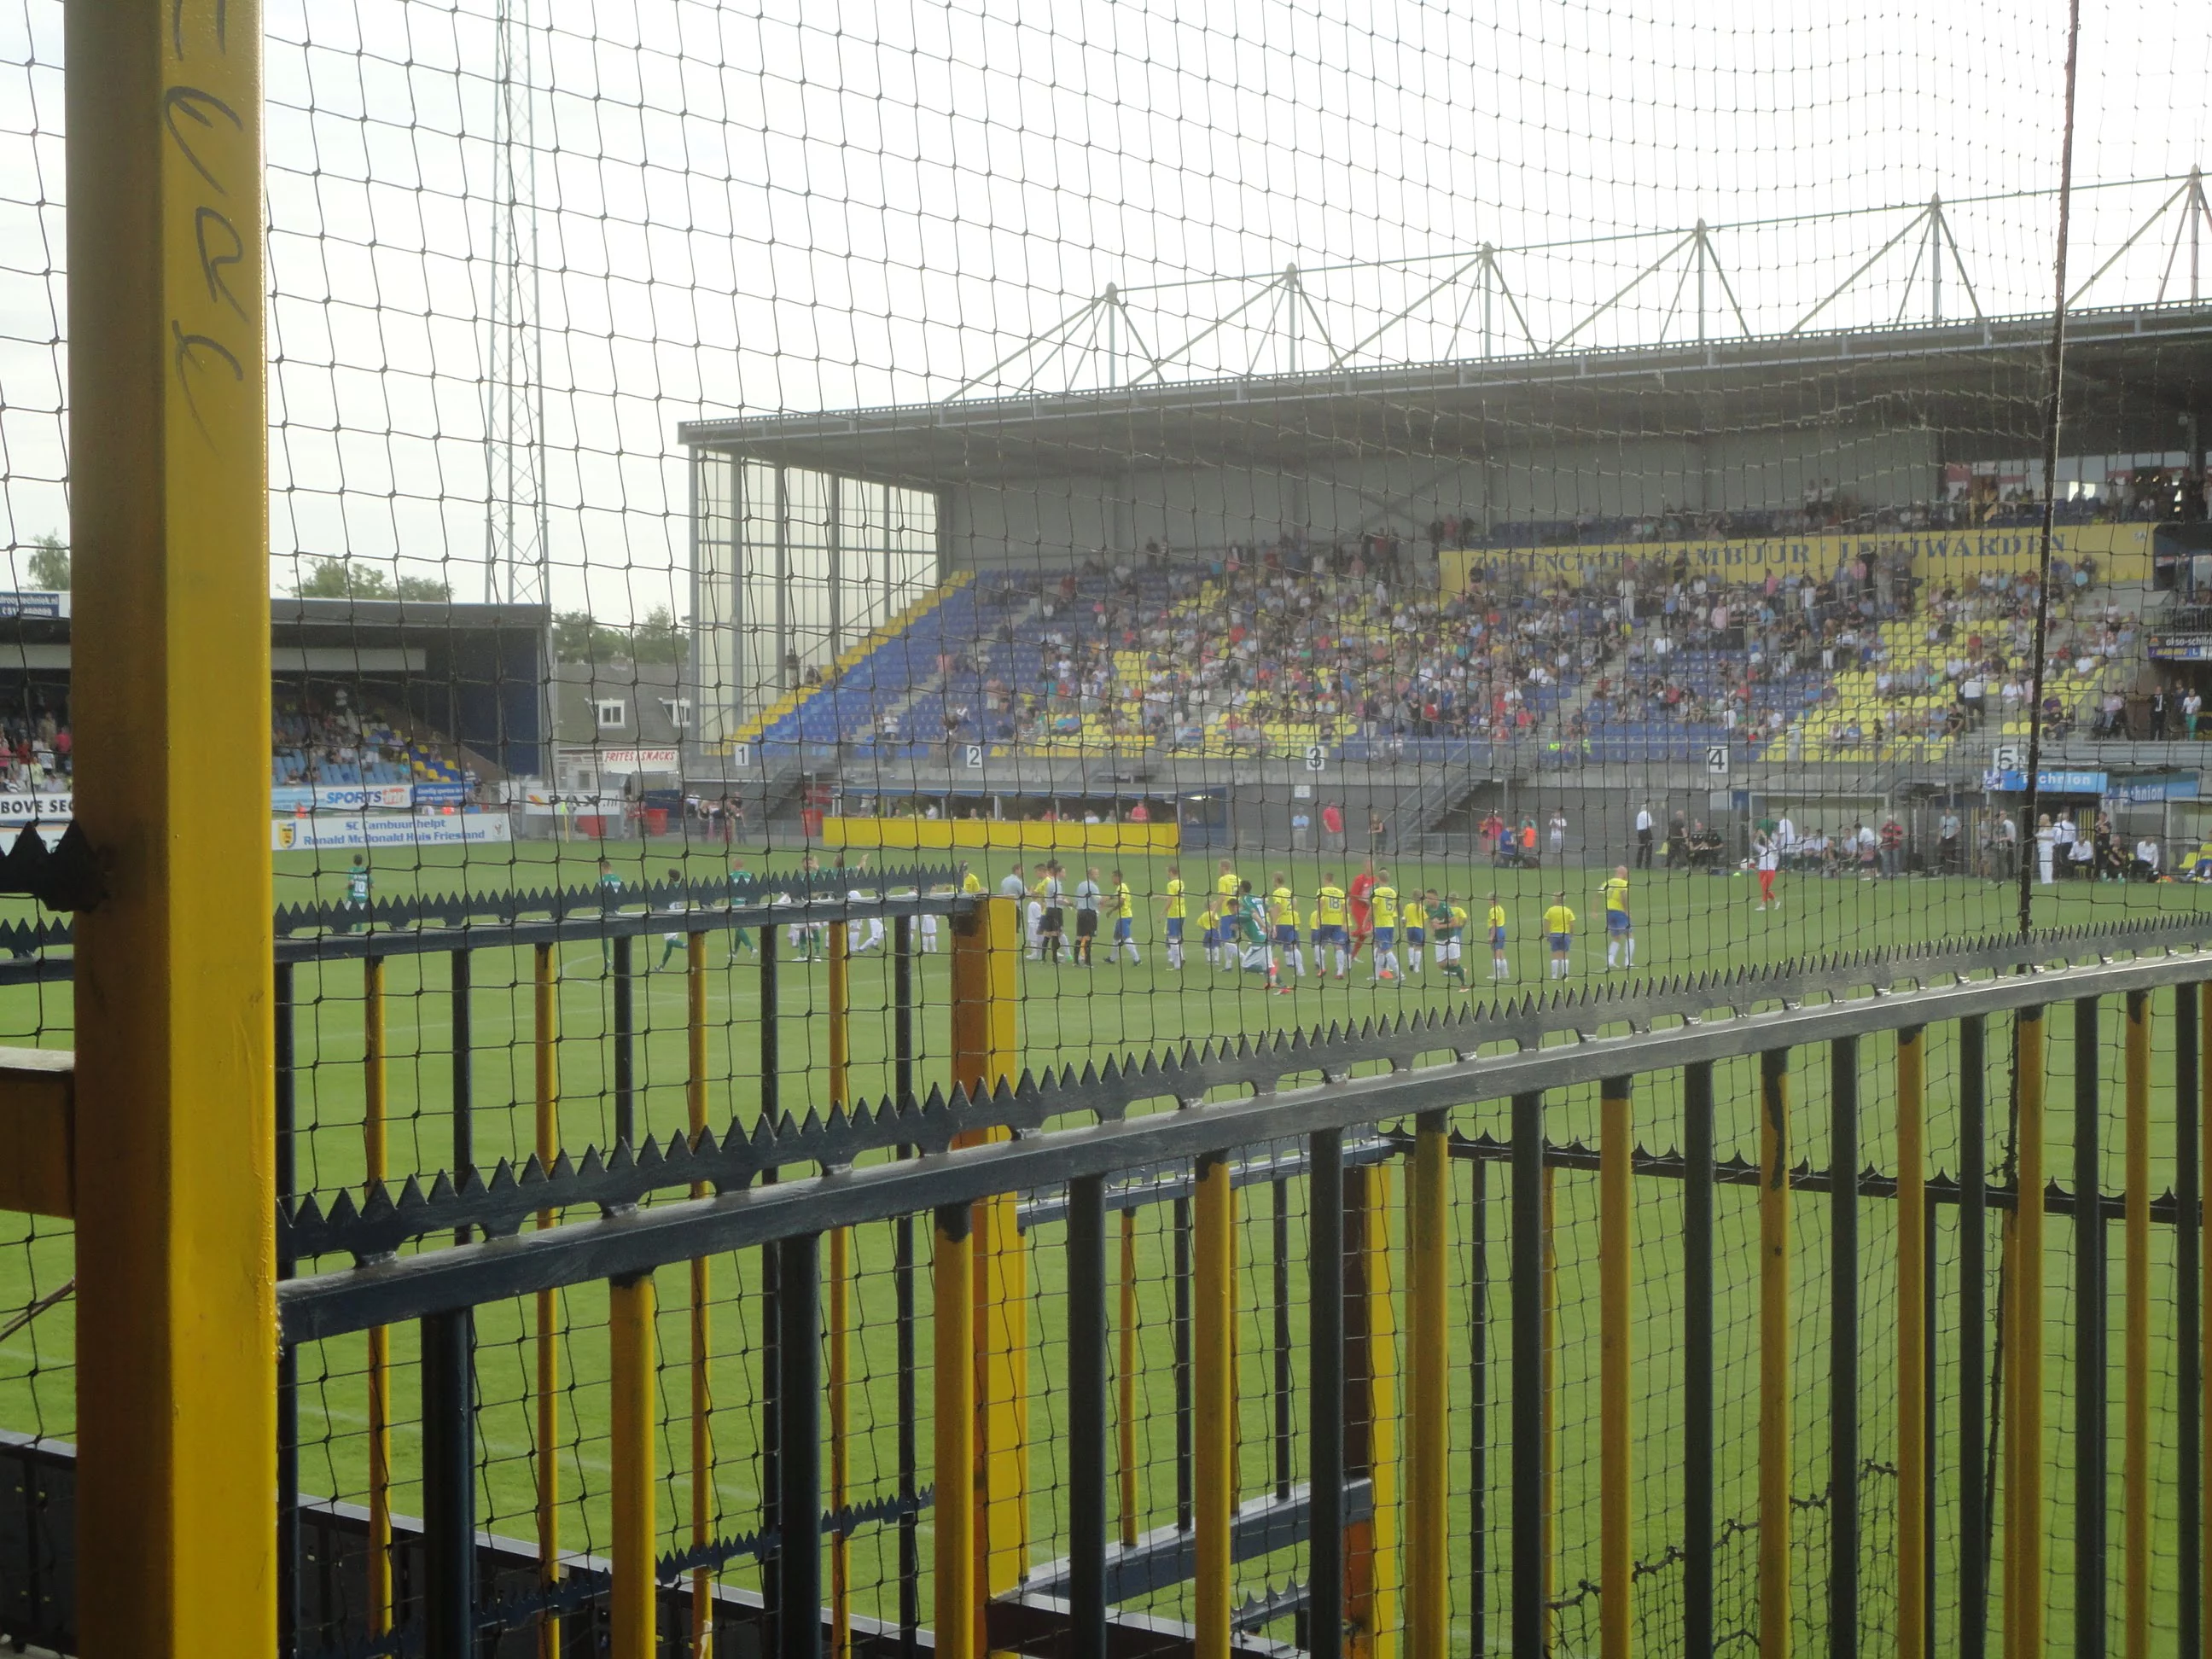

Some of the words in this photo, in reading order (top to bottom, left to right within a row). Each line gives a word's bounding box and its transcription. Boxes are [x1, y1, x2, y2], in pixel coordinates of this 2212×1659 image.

[1840, 533, 2065, 563] LWARDEN
[604, 751, 634, 762] FRITES
[640, 751, 675, 762] SNACKS
[737, 746, 745, 765] 1
[969, 747, 981, 765] 2
[1309, 748, 1322, 768] 3
[1709, 749, 1725, 771] 4
[362, 820, 415, 830] ambuur
[416, 818, 445, 830] helpt
[303, 835, 345, 845] Ronald
[347, 833, 404, 844] McDonald
[434, 830, 486, 841] Friesand
[1329, 897, 1340, 909] 18
